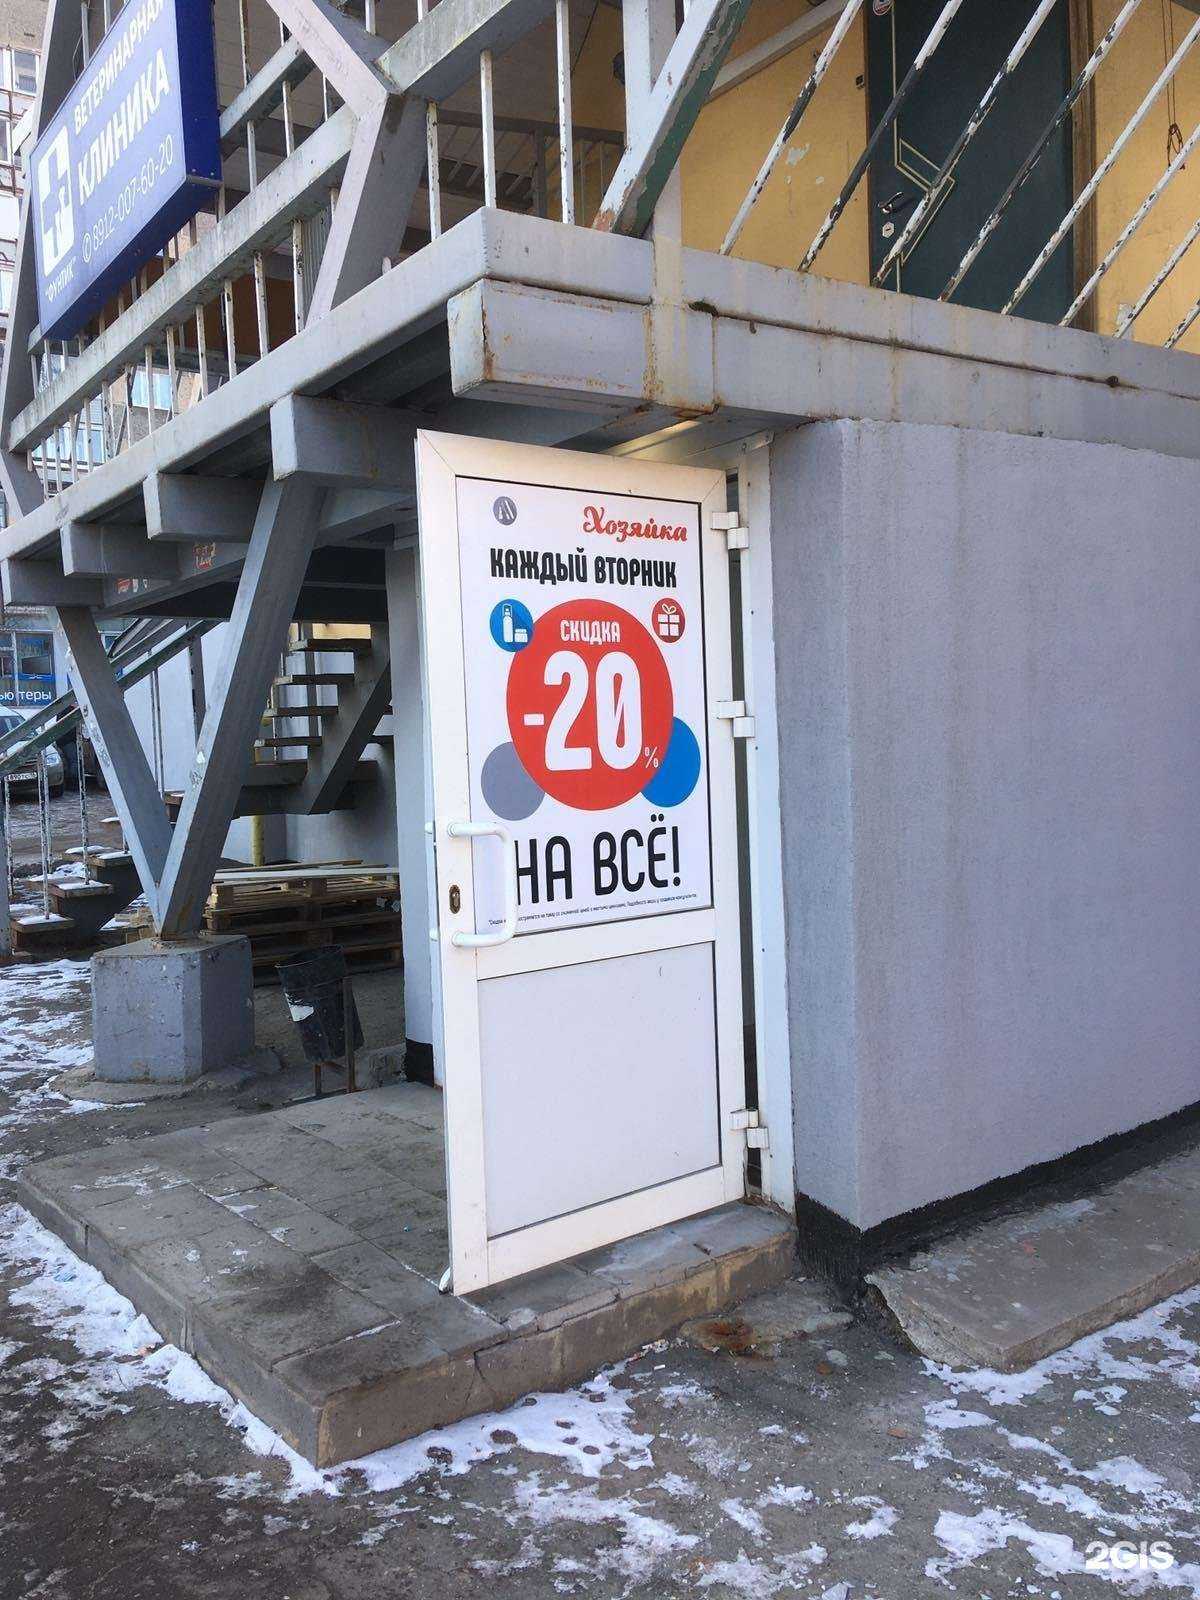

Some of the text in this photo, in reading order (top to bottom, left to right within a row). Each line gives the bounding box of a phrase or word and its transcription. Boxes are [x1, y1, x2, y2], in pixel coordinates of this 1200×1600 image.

[77, 47, 170, 206] КЛИНИКА
[92, 134, 174, 250] 8912-007-60-20
[583, 506, 688, 543] Хозяйка
[490, 546, 677, 588] КАЖДЫЙ ВТОРНИК
[560, 619, 621, 645] СКИДКА
[514, 813, 681, 906] НА ВСЁ!
